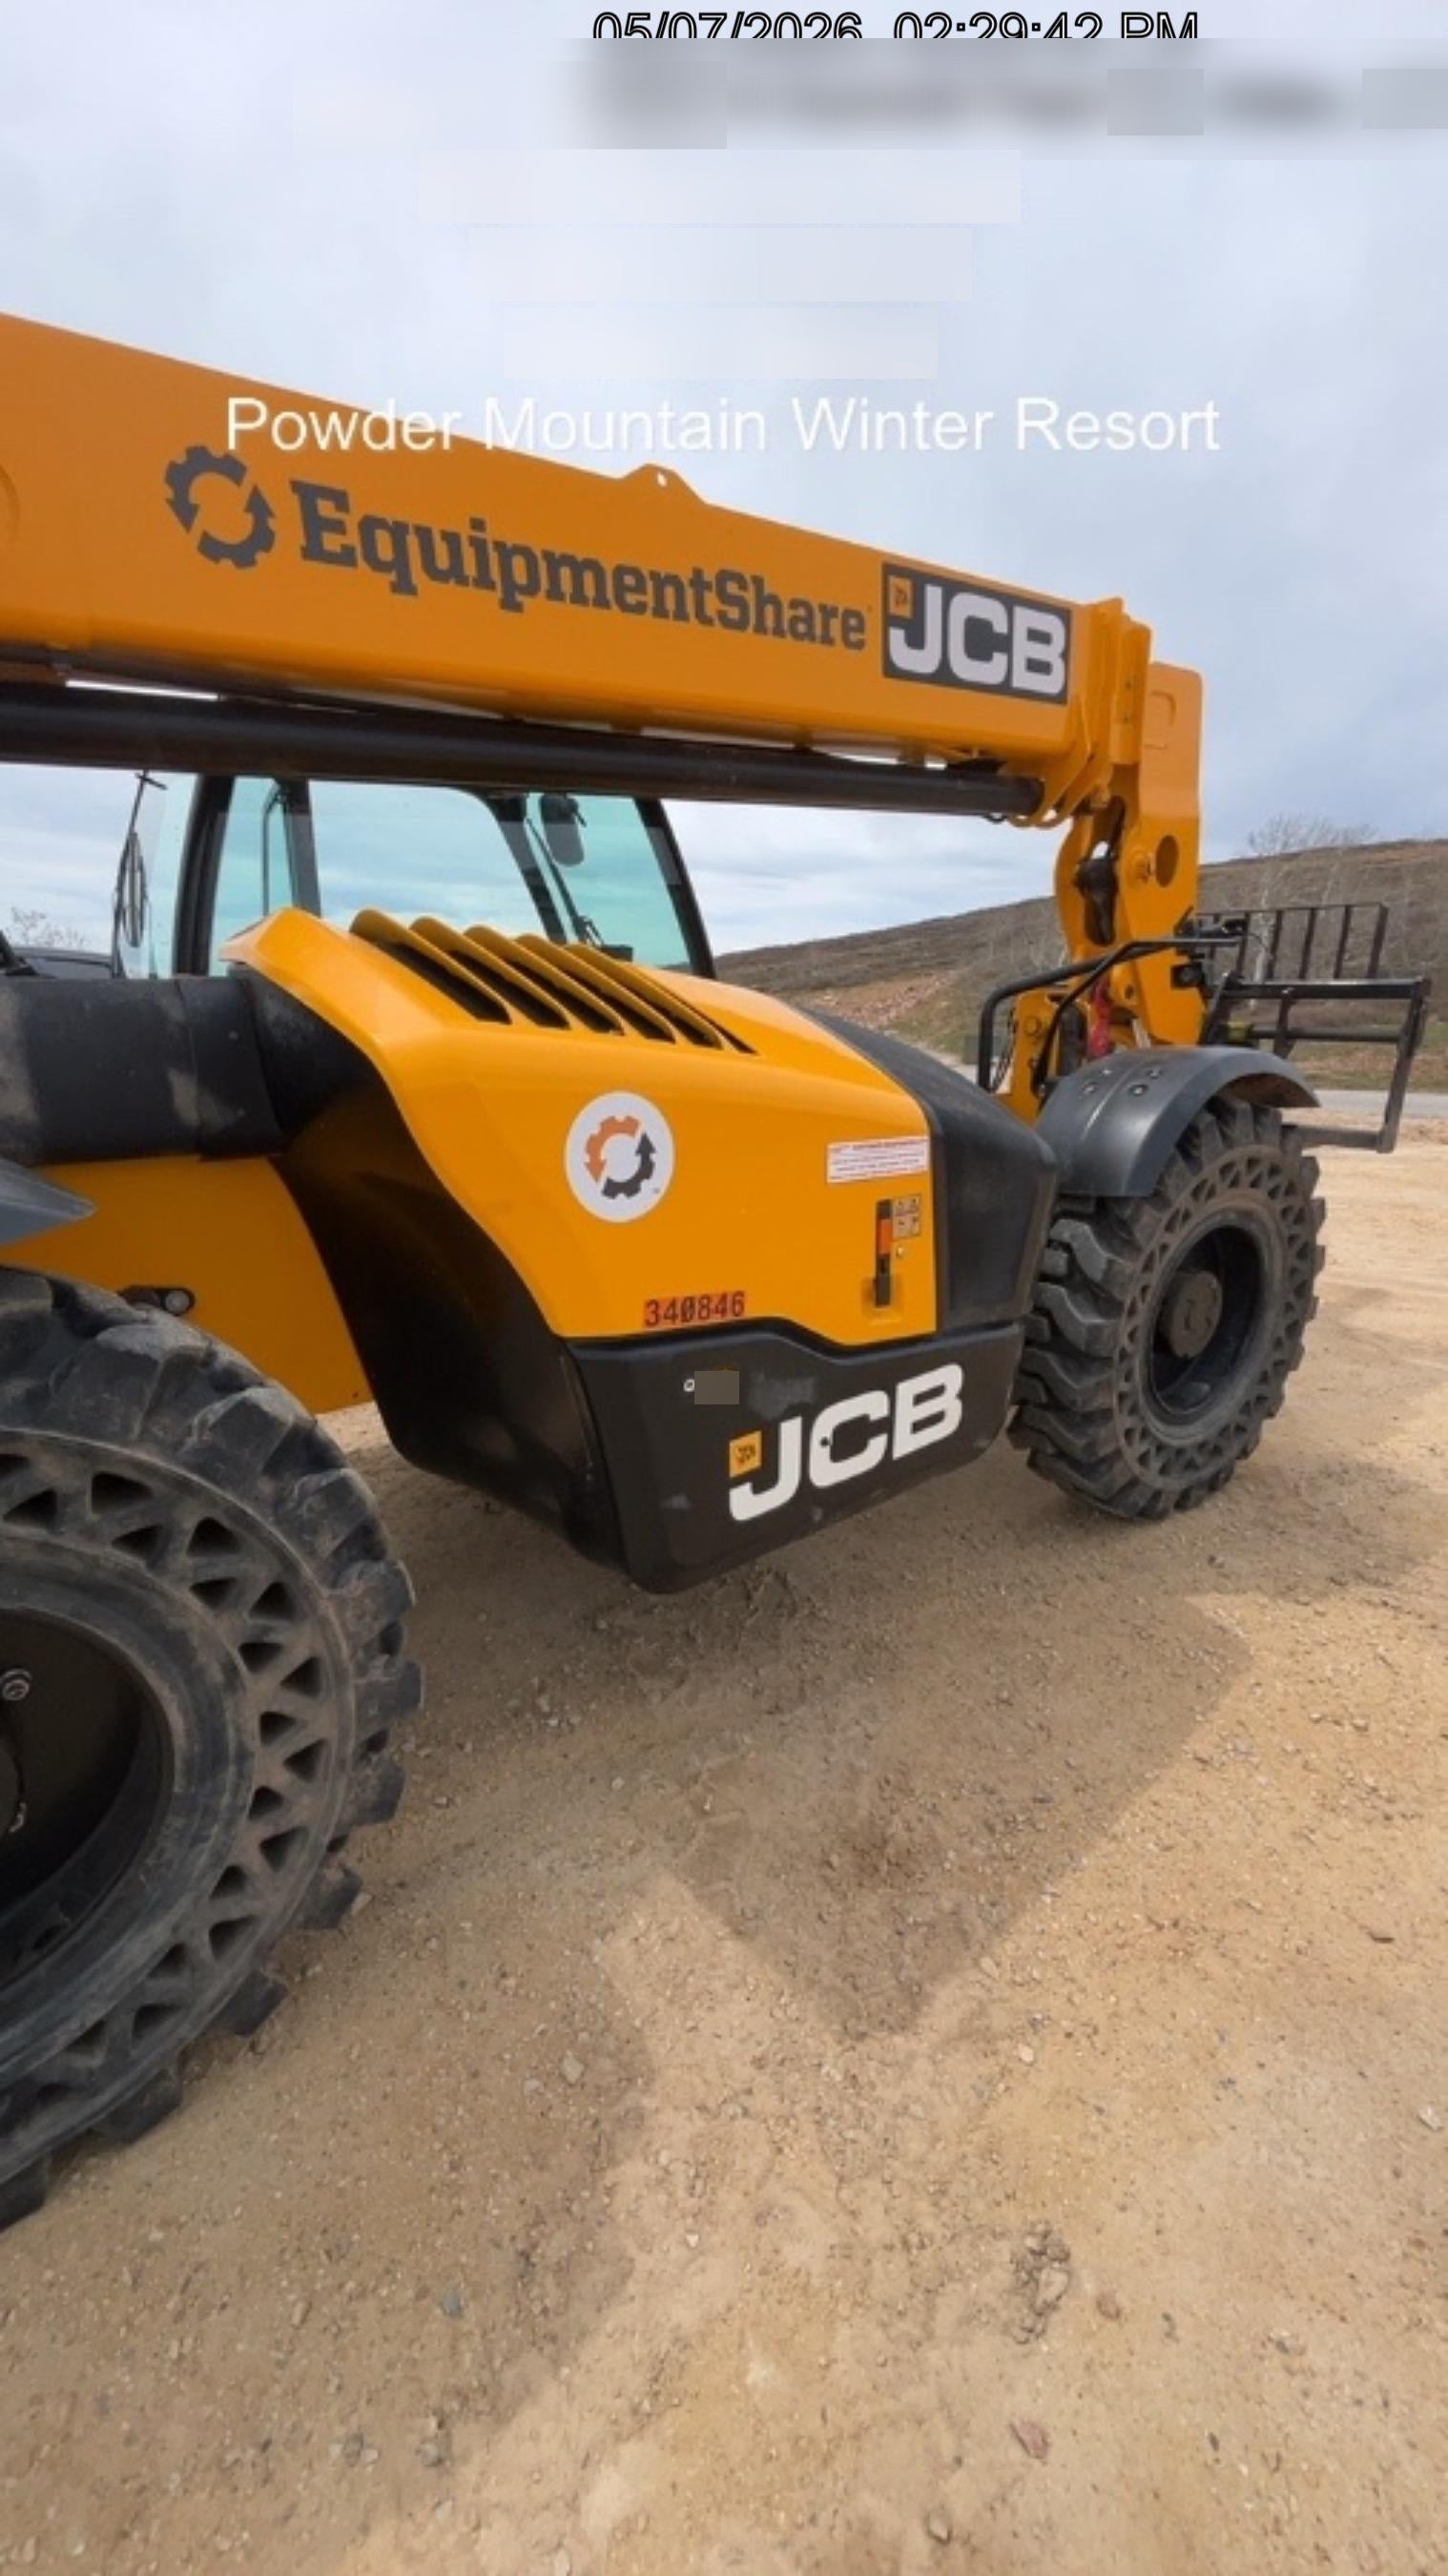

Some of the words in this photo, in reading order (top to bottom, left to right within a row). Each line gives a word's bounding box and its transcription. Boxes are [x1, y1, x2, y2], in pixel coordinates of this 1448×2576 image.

[290, 479, 866, 653] EquipmentShare
[889, 583, 1066, 696] JCB
[645, 1289, 746, 1327] 340846
[729, 1362, 963, 1522] JCB
